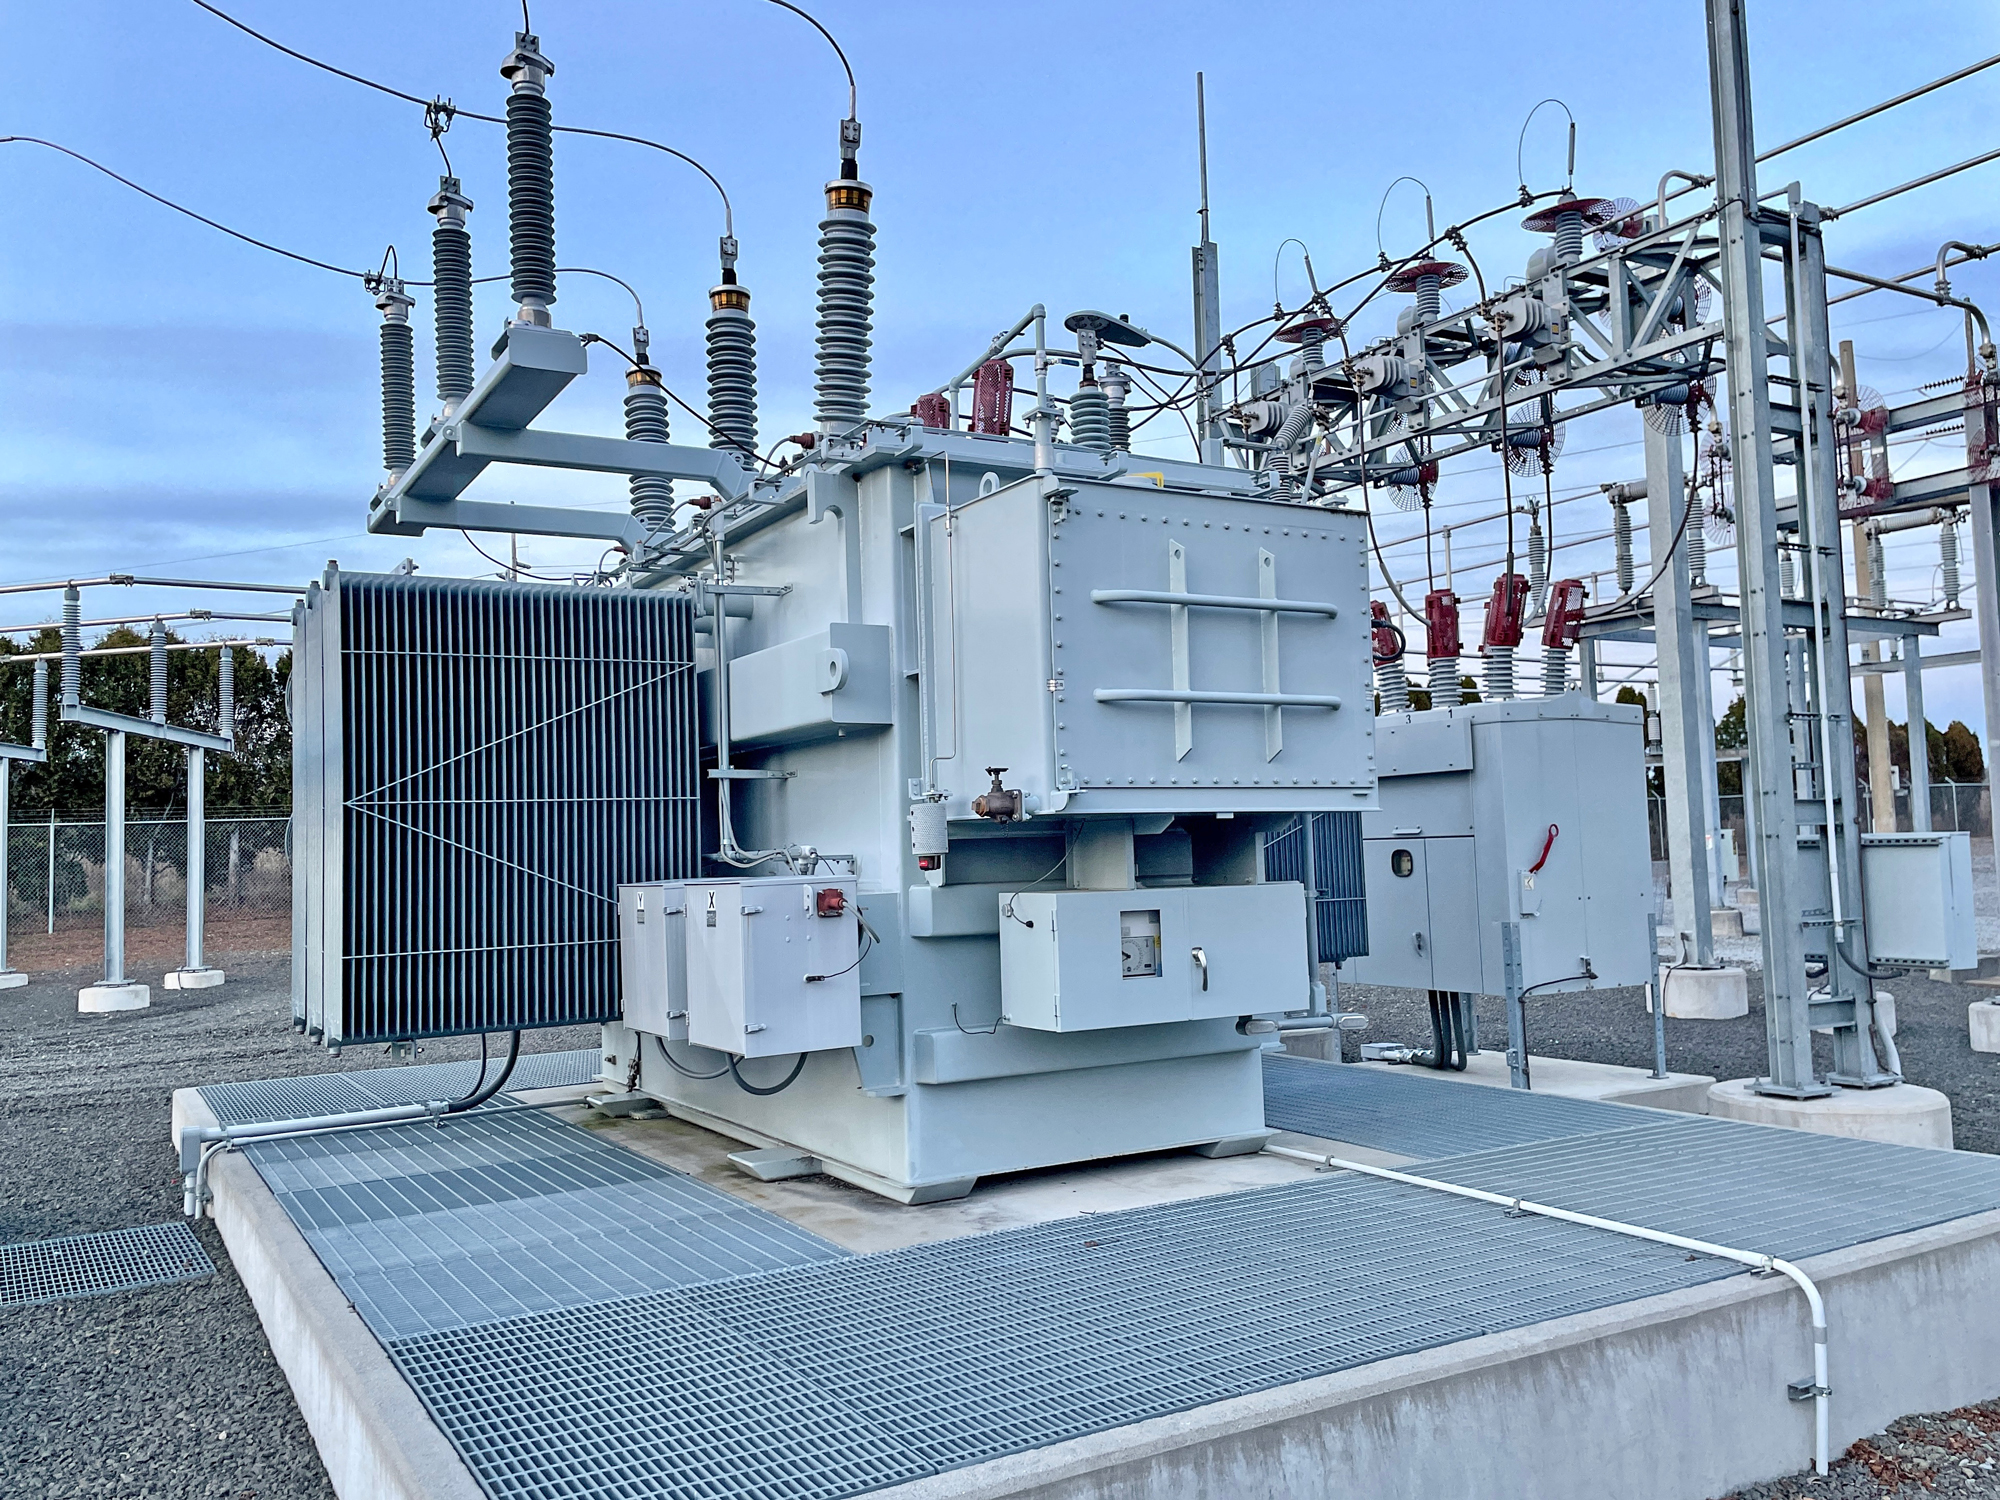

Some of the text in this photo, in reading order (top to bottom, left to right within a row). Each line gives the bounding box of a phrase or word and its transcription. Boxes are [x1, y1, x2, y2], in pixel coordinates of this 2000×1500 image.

[1405, 714, 1411, 724] 3
[1448, 709, 1453, 719] 1
[637, 893, 643, 908] Y
[708, 891, 715, 909] X
